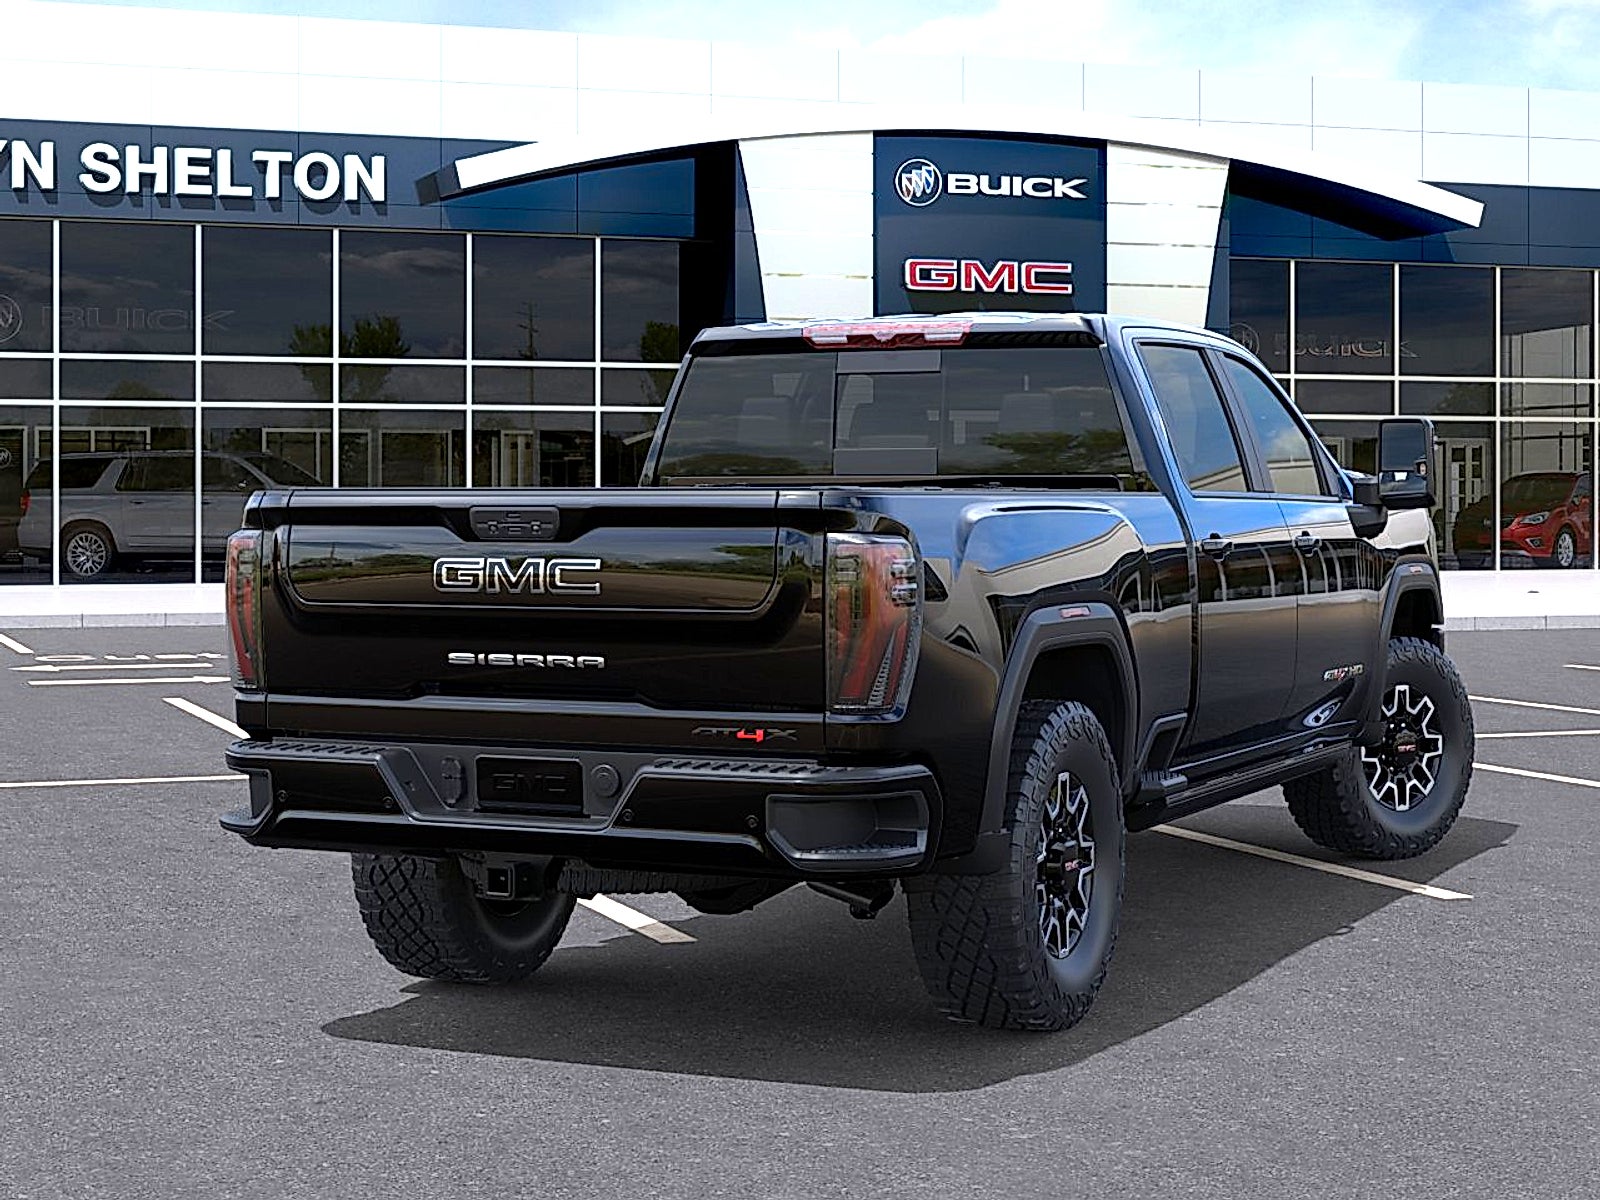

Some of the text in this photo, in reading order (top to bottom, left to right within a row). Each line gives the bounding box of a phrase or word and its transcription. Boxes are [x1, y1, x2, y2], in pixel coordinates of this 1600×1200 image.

[0, 139, 386, 202] N SHELTON
[948, 173, 1088, 199] BUICK
[904, 258, 1073, 294] GMC
[434, 557, 601, 595] GMC
[447, 652, 605, 669] SIERRA
[692, 727, 797, 742] AT4X
[491, 773, 566, 793] GMC
